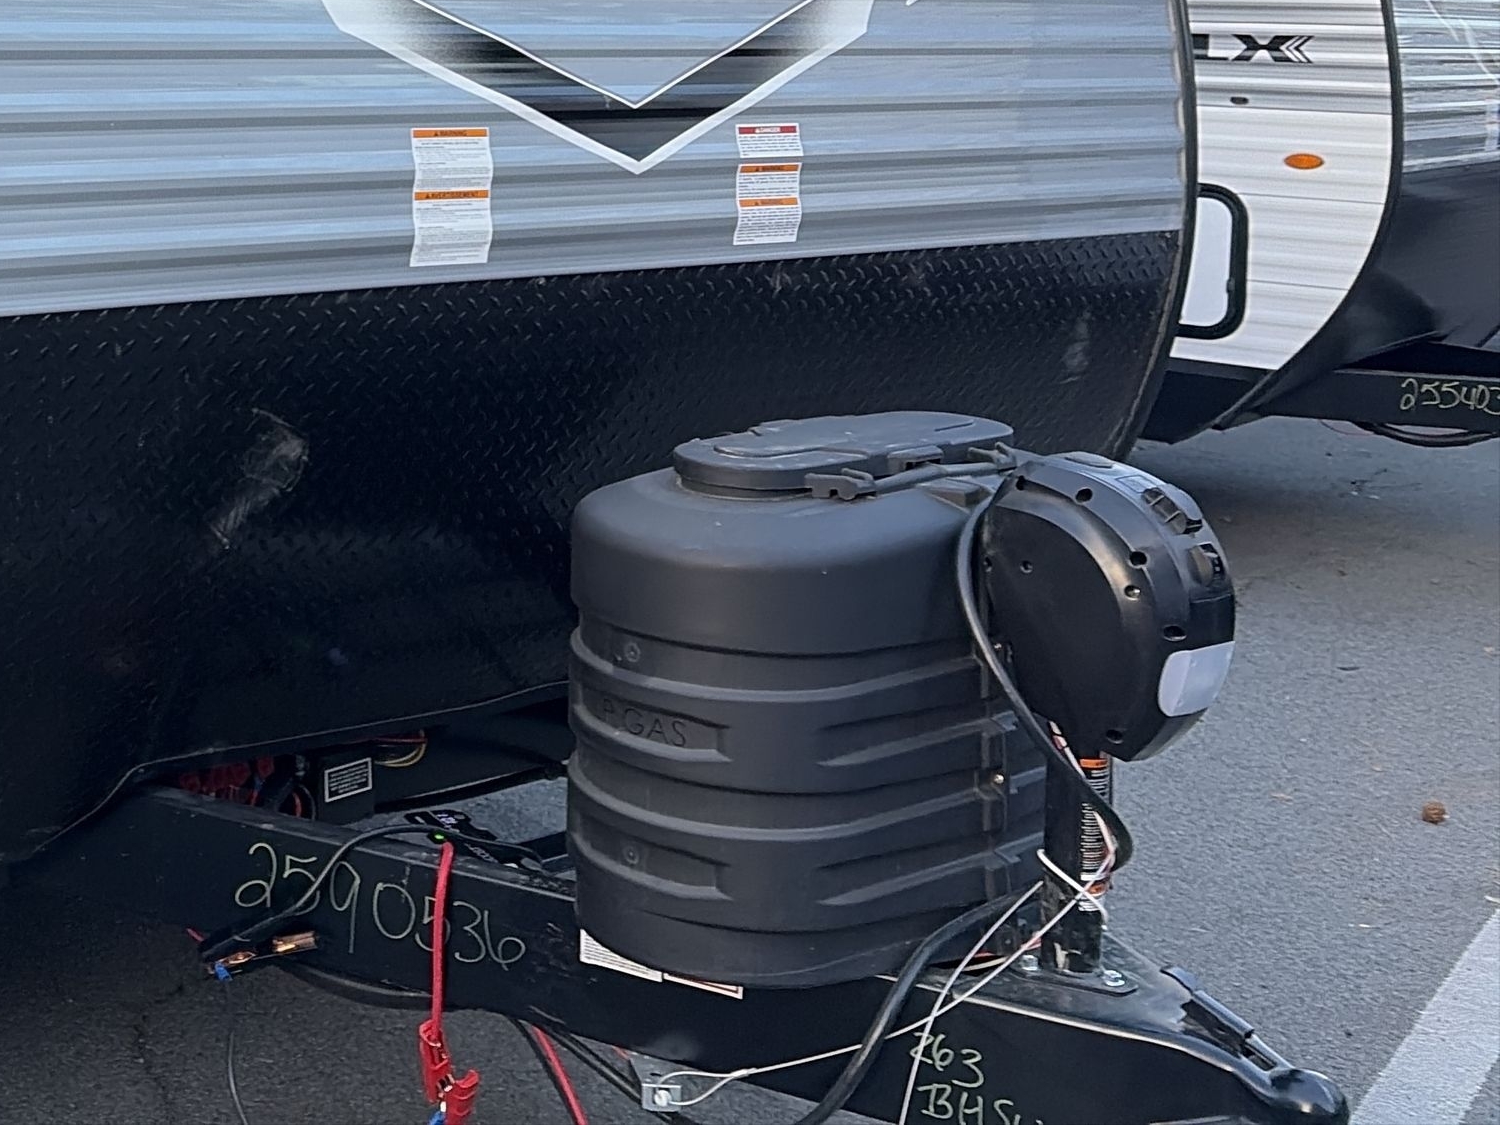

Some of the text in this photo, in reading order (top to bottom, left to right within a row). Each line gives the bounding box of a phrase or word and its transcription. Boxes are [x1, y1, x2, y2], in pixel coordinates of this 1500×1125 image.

[1192, 33, 1315, 63] LX
[624, 707, 687, 747] GAS
[234, 842, 526, 972] 2590536
